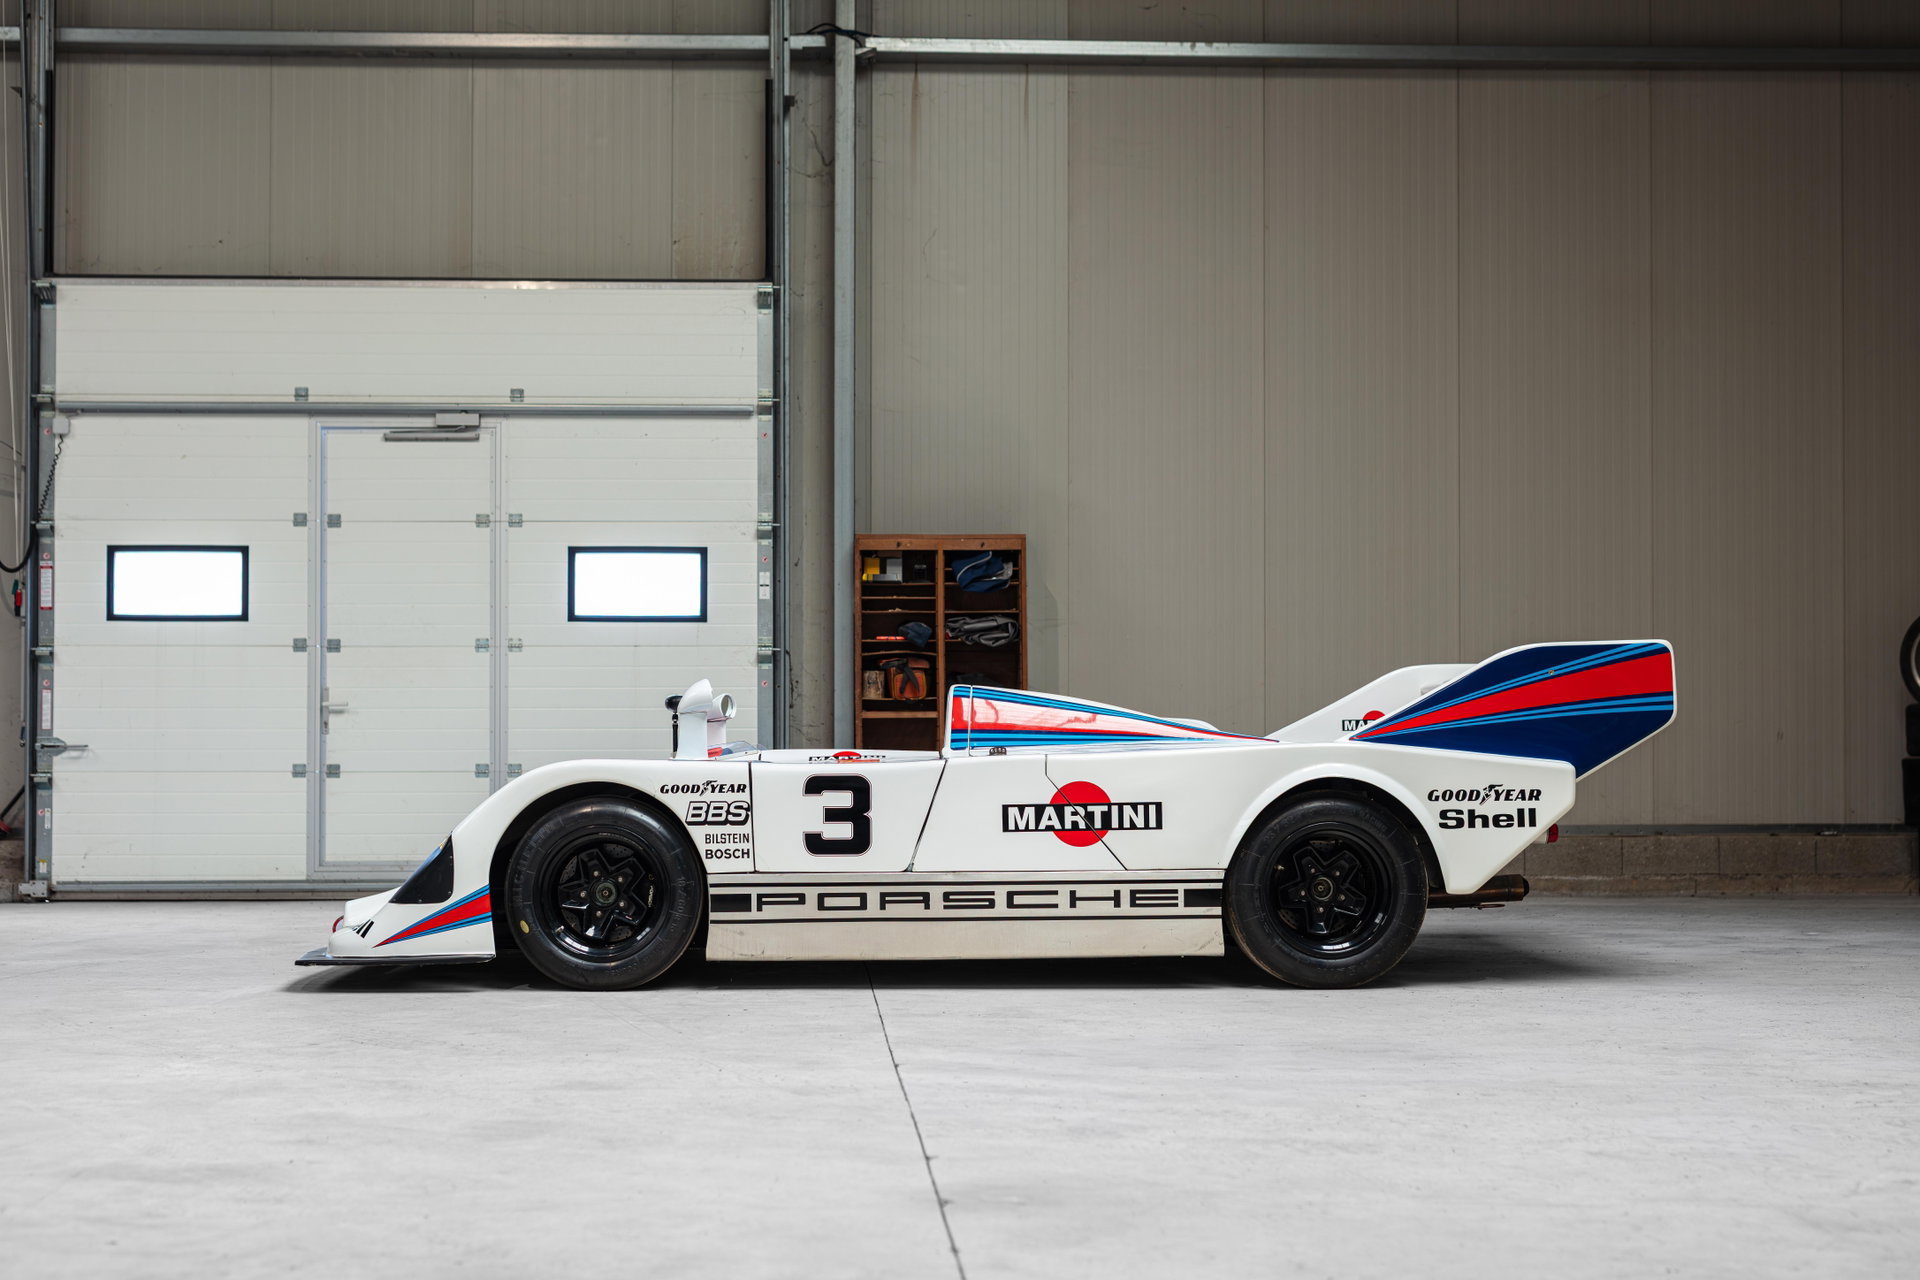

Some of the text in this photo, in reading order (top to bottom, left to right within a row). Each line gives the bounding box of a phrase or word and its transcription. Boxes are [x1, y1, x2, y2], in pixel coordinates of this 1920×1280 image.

[1343, 719, 1375, 731] MA
[685, 801, 750, 826] BBS
[802, 773, 873, 857] 3
[1007, 804, 1157, 831] MARTINI
[1438, 808, 1537, 829] Shell
[704, 833, 750, 844] BILSTEIN
[704, 848, 750, 859] BOSCH
[756, 888, 1179, 912] PORSCHE
